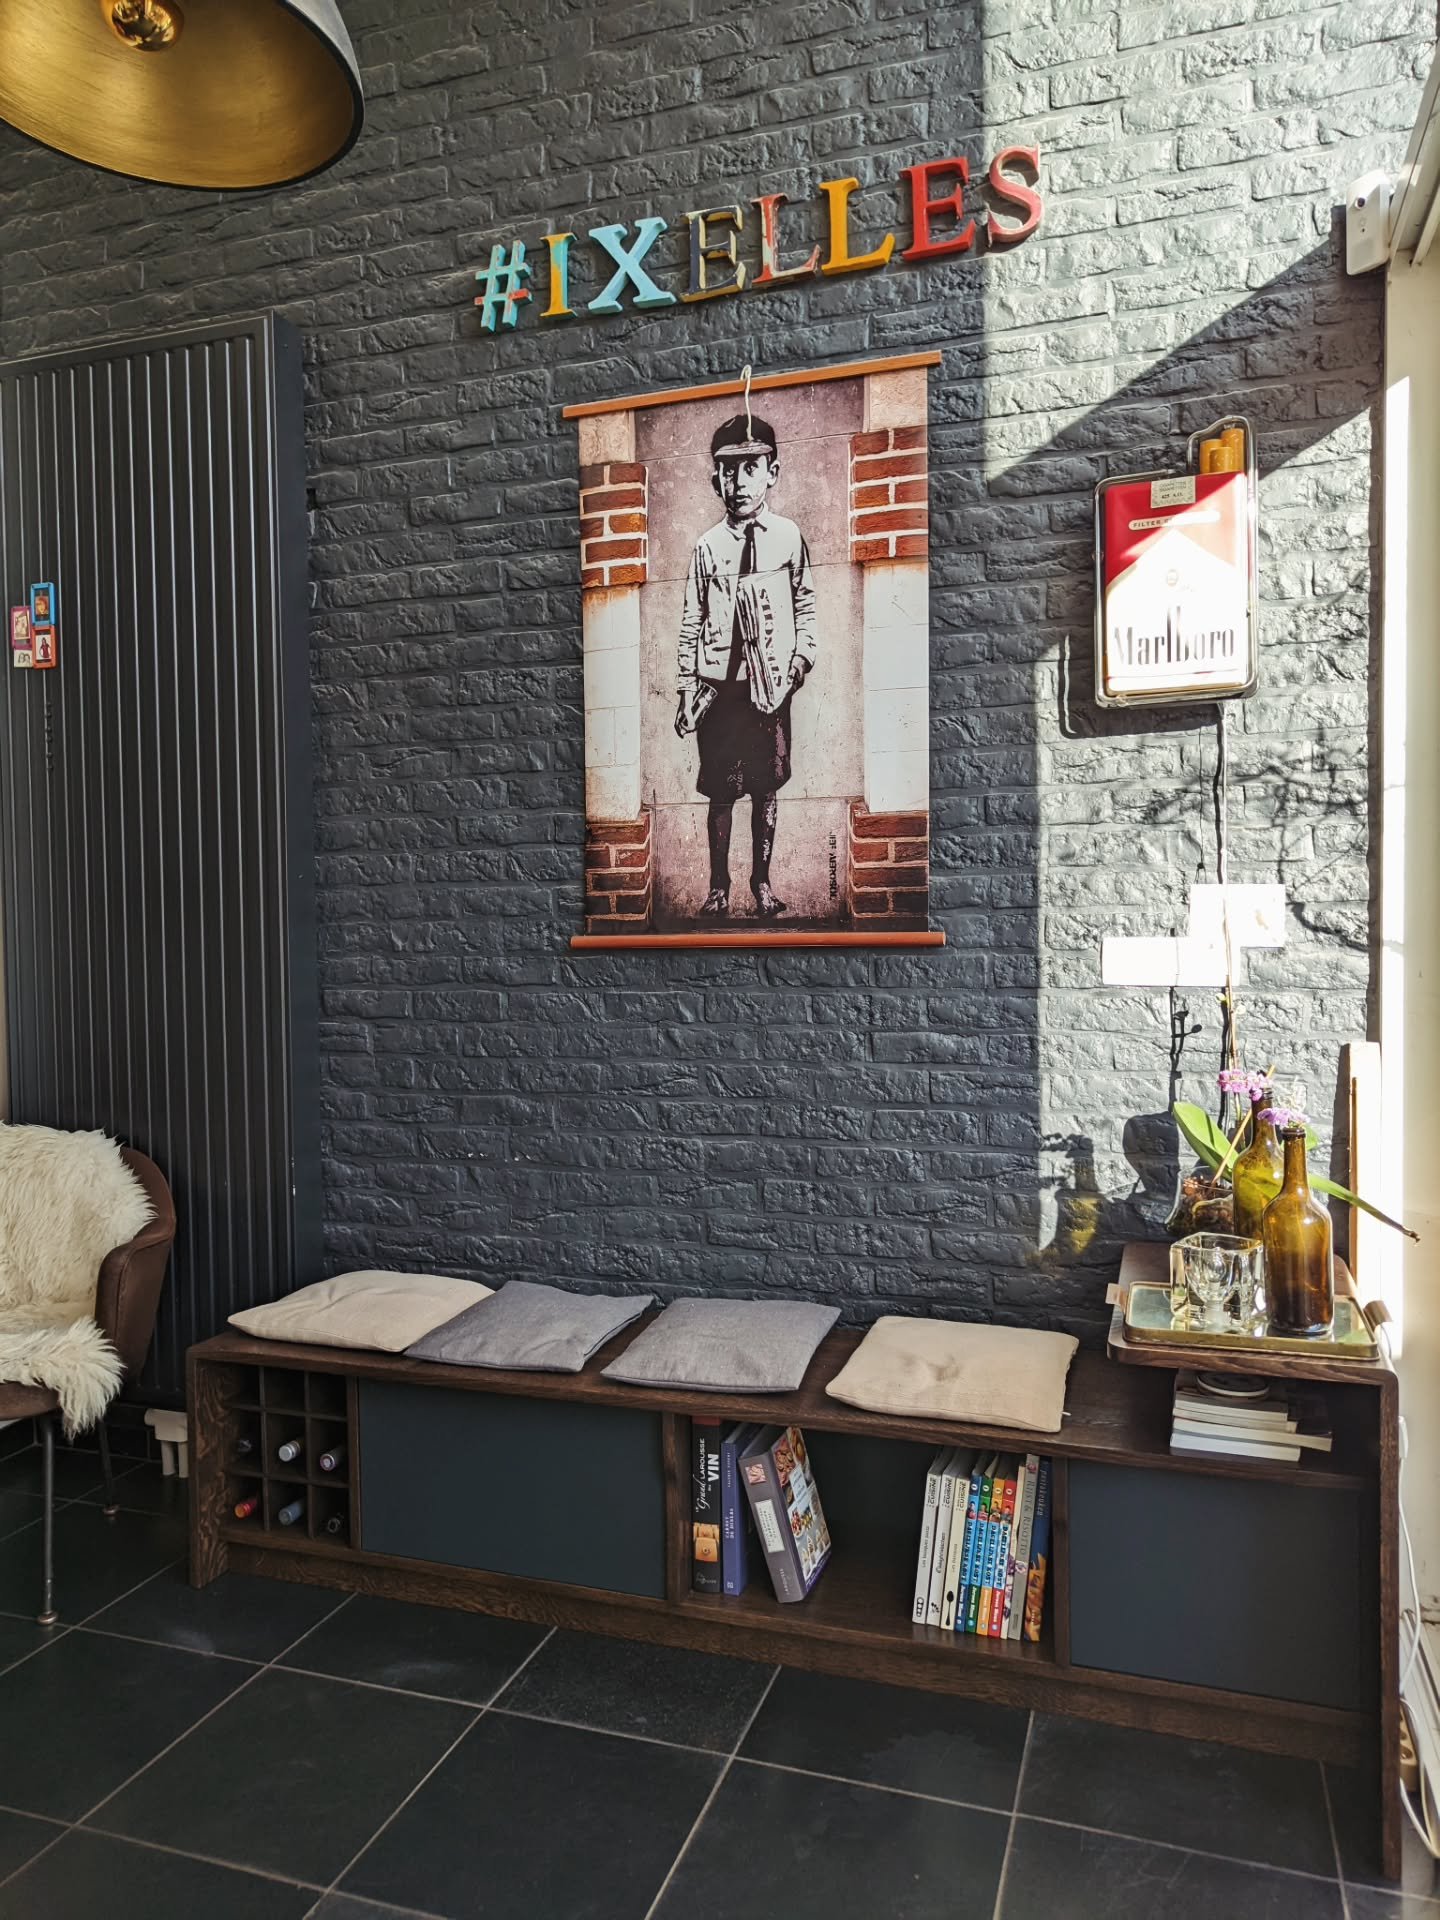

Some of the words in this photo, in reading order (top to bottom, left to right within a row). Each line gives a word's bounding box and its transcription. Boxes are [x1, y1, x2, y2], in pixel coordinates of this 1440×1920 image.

[474, 144, 1042, 332] #IXELLES
[1133, 519, 1161, 528] FILTER
[760, 588, 782, 688] STENCILS
[1114, 606, 1235, 666] Marlboro
[708, 1453, 720, 1482] VIN
[1020, 1516, 1031, 1555] RISOTTO
